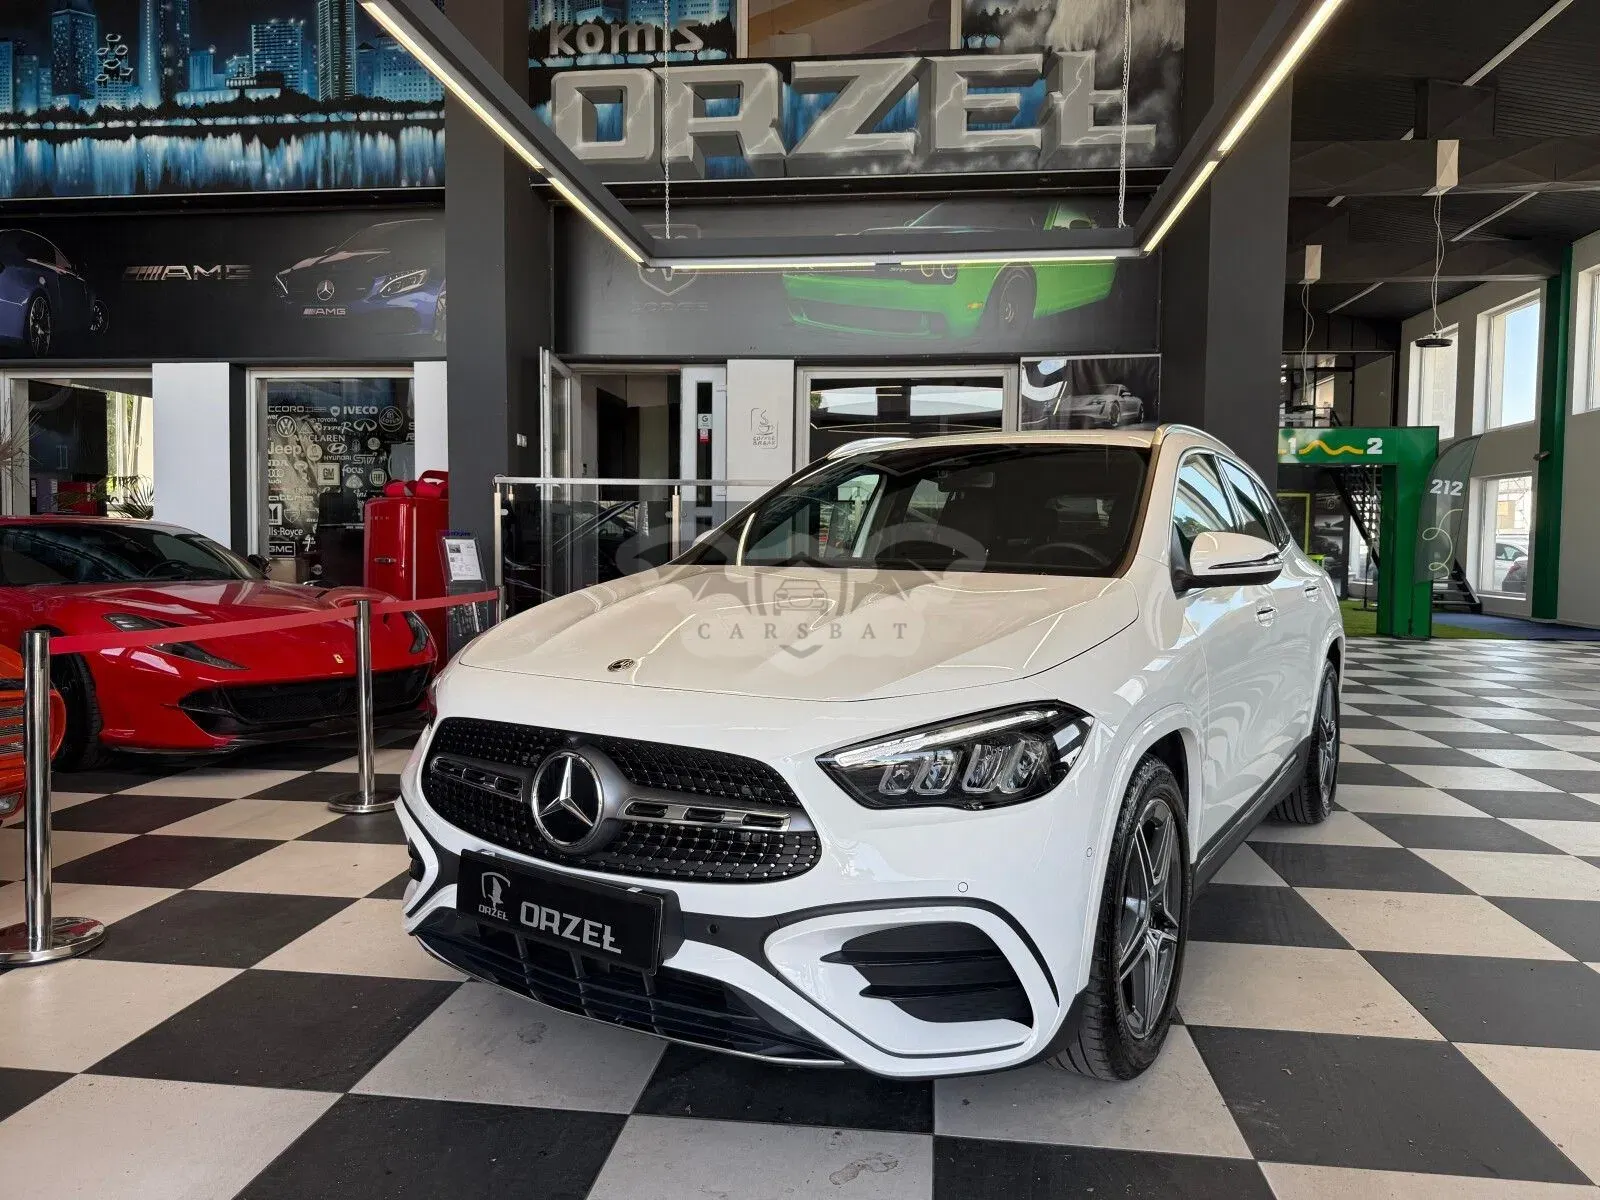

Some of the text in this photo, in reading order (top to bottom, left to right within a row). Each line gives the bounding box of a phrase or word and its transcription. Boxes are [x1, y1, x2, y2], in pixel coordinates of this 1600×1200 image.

[551, 50, 1157, 172] ORZEŁ
[315, 307, 346, 316] AMG
[343, 405, 379, 415] IVECO
[267, 441, 302, 458] Jeep
[1366, 437, 1383, 455] 2
[342, 463, 364, 477] focus
[1429, 479, 1464, 496] 212
[478, 904, 509, 921] ORZEŁ
[520, 900, 622, 954] ORZEŁ
